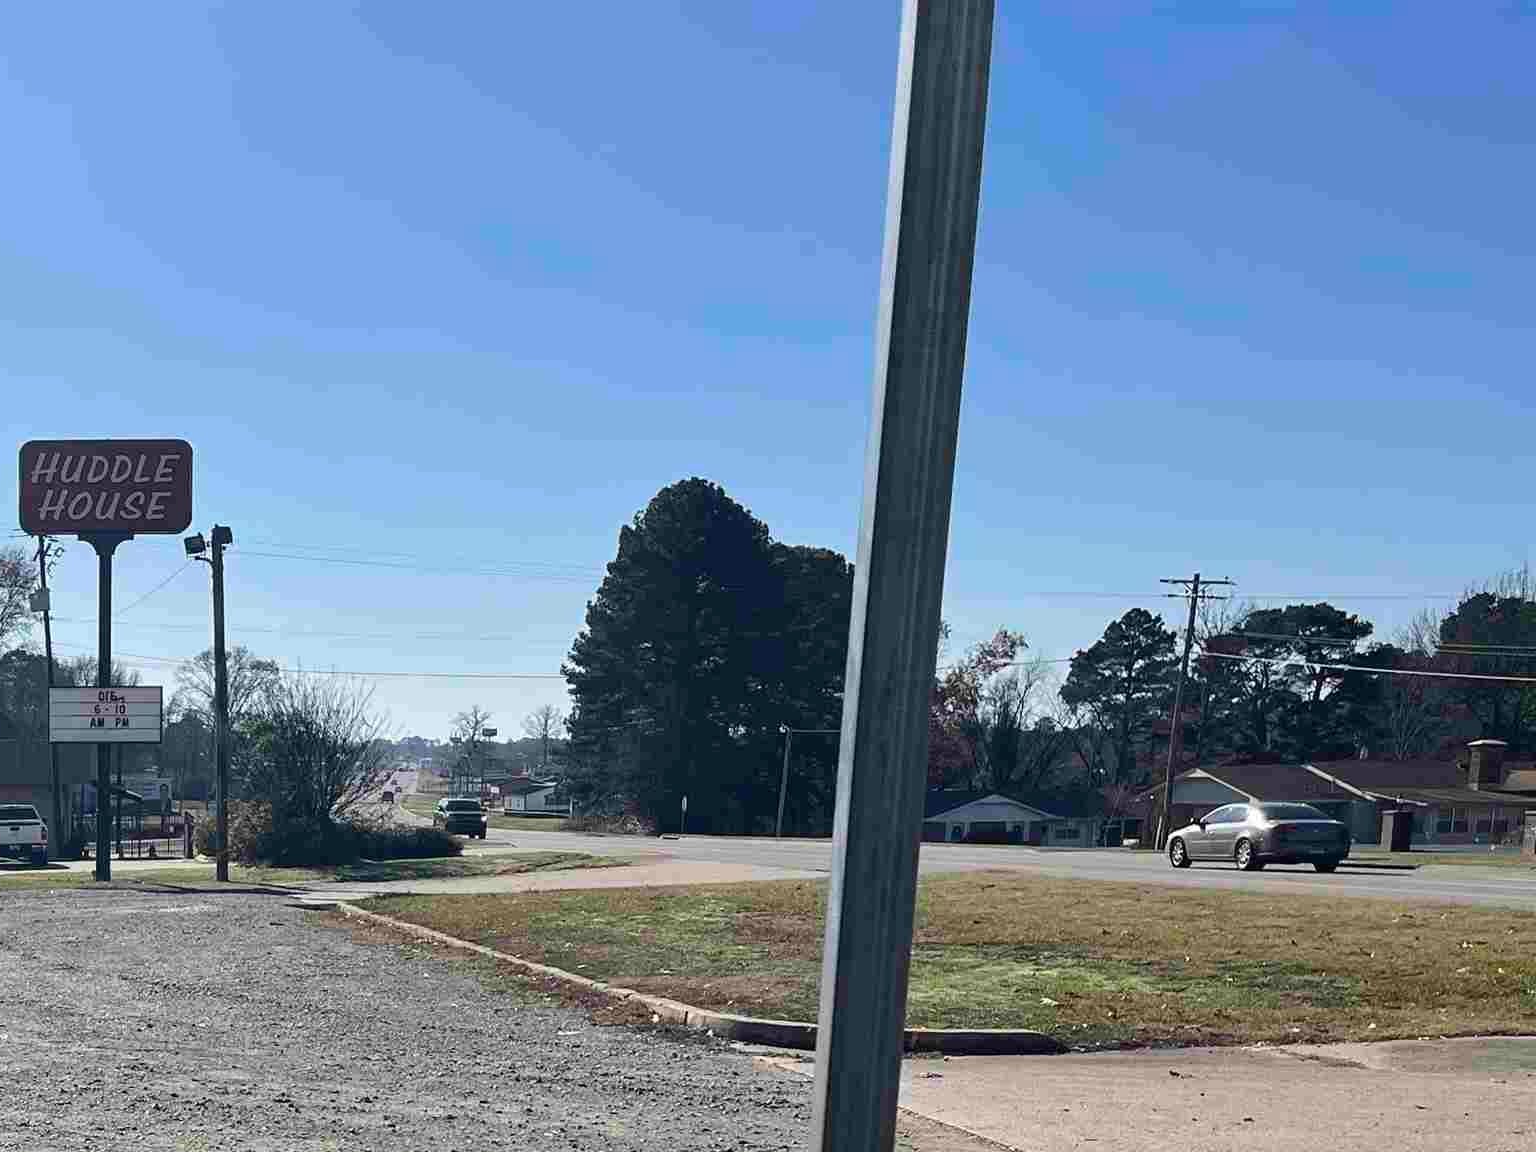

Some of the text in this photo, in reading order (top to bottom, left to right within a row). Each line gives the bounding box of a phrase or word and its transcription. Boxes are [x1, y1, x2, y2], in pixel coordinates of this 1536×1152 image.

[31, 452, 181, 484] HUDDLE
[38, 489, 172, 521] HOUSE
[94, 704, 102, 714] 6
[115, 704, 127, 714] 10
[89, 717, 129, 729] AM PM
